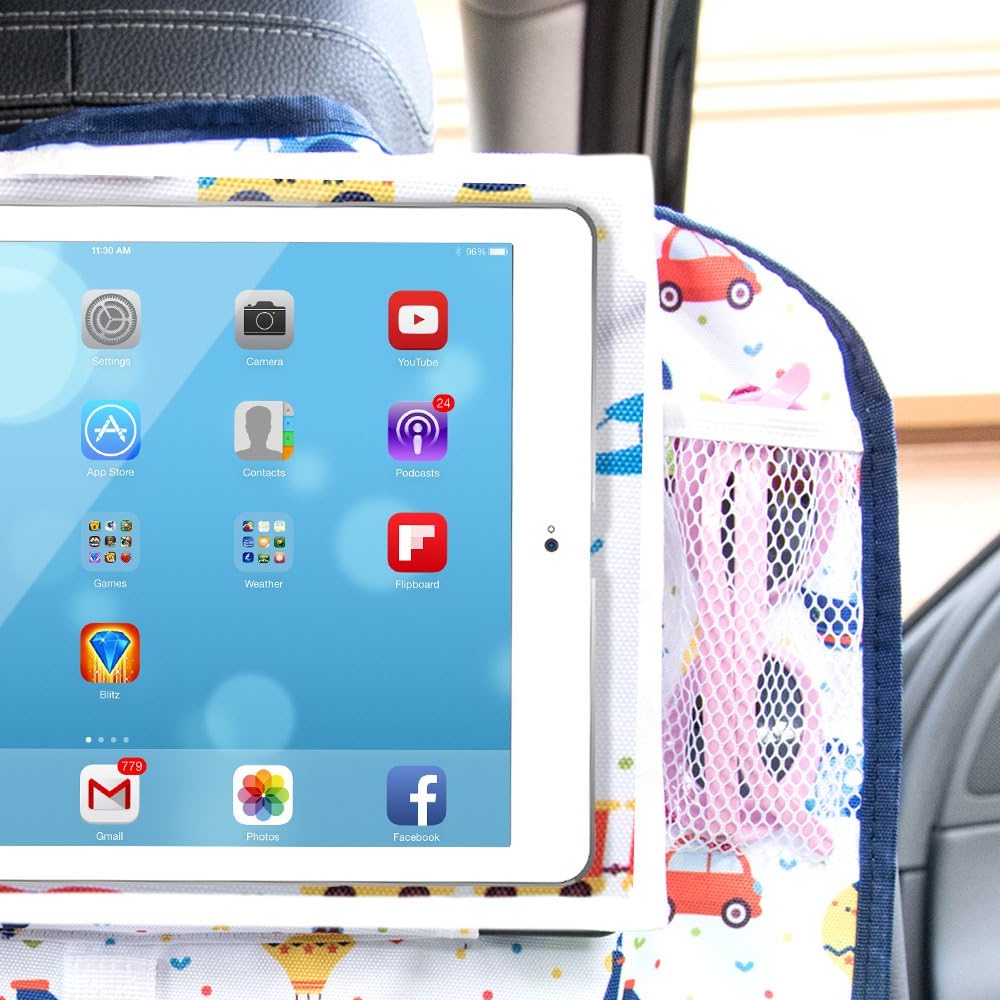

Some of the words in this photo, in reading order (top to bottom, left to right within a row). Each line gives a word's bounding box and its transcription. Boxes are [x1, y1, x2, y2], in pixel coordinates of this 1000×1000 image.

[92, 246, 114, 255] 11:30
[116, 247, 131, 255] AM
[466, 247, 486, 256] 96%
[92, 356, 131, 367] Settings
[246, 357, 283, 366] Camera
[398, 357, 440, 367] YouTube
[437, 399, 451, 408] 24
[87, 467, 106, 478] App
[110, 468, 134, 477] Store
[243, 468, 286, 477] Contacts
[396, 467, 440, 477] Podcasts
[94, 578, 128, 588] Games
[244, 579, 283, 589] Weather
[395, 580, 440, 590] Flipboard
[100, 690, 120, 699] Blitz
[122, 761, 143, 772] 779
[410, 774, 437, 826] f
[96, 831, 123, 841] Gmail
[246, 832, 279, 842] Photos
[394, 833, 440, 842] Facebook
